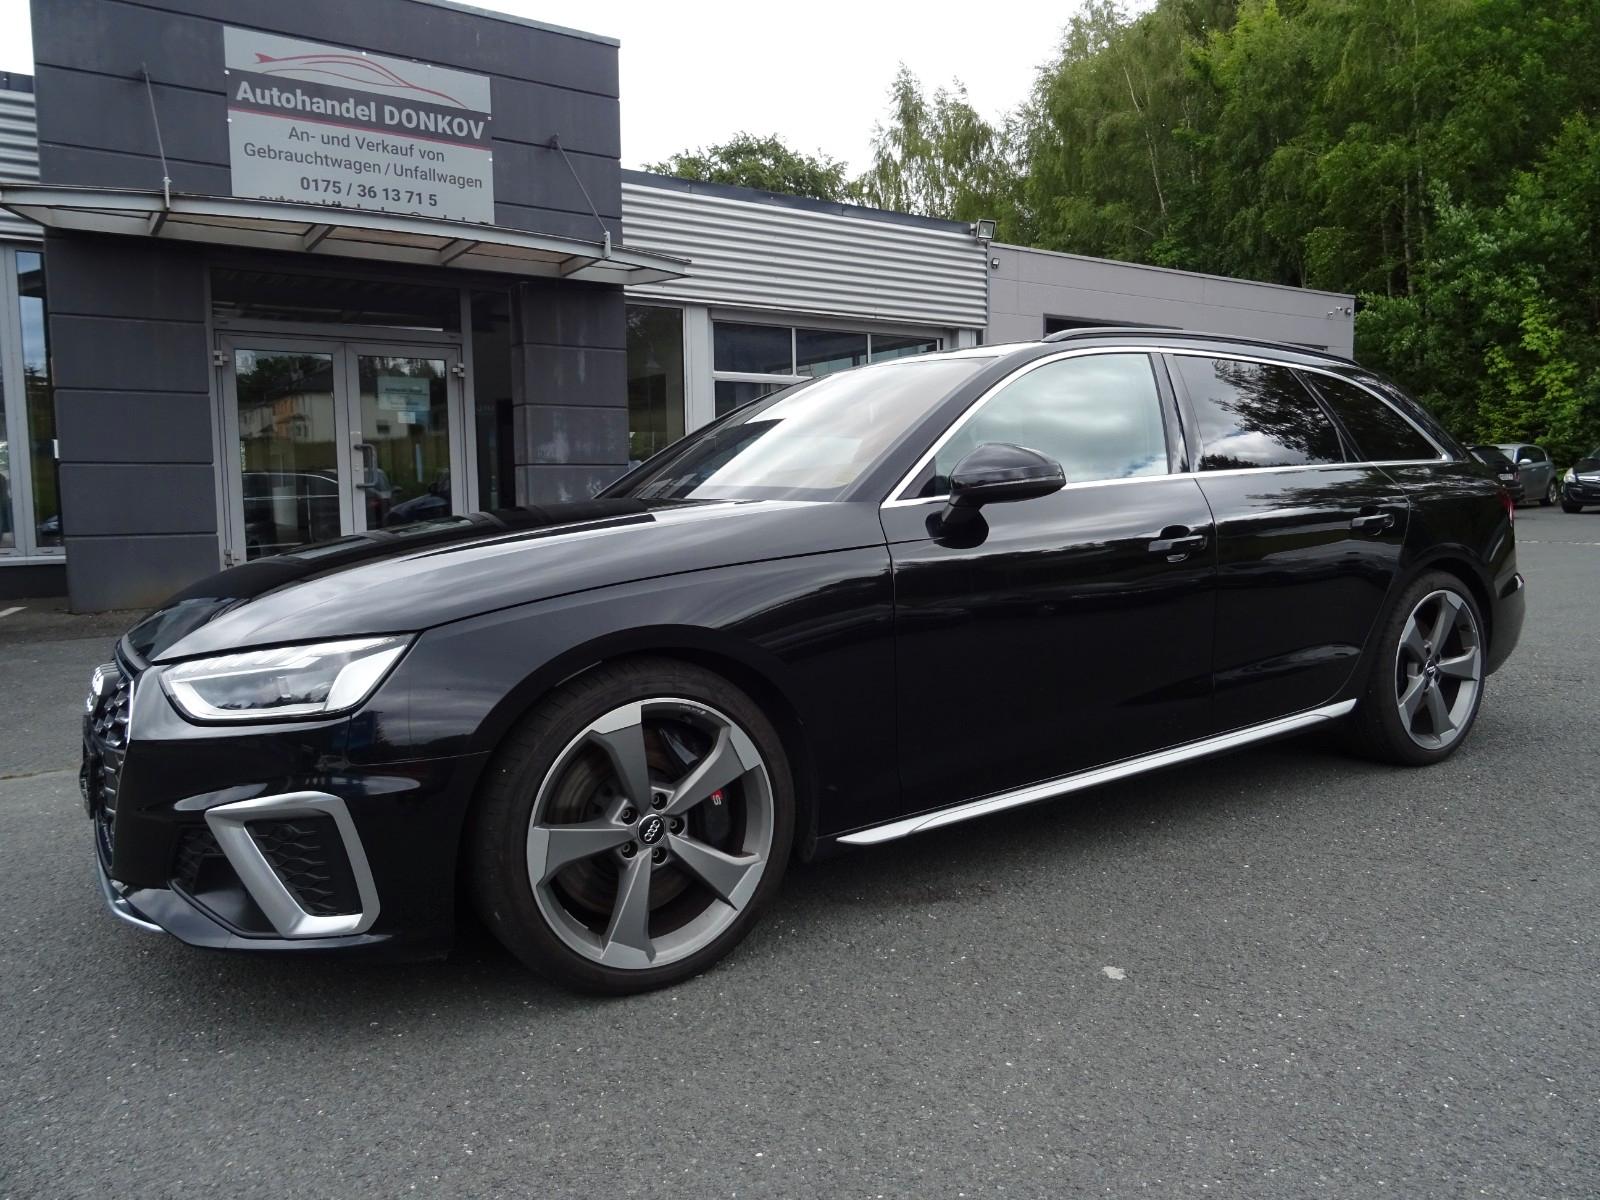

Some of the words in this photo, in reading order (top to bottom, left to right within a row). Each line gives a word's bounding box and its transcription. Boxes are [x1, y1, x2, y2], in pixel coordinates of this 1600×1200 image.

[235, 80, 377, 123] Autohandel
[384, 105, 485, 139] DONKOV
[288, 126, 316, 142] An-
[321, 134, 350, 148] und
[355, 136, 415, 157] Verkauf
[418, 148, 445, 162] von
[243, 142, 382, 175] Gebrauchtwagen
[393, 165, 483, 189] Unfallwagen
[300, 176, 342, 195] 0175
